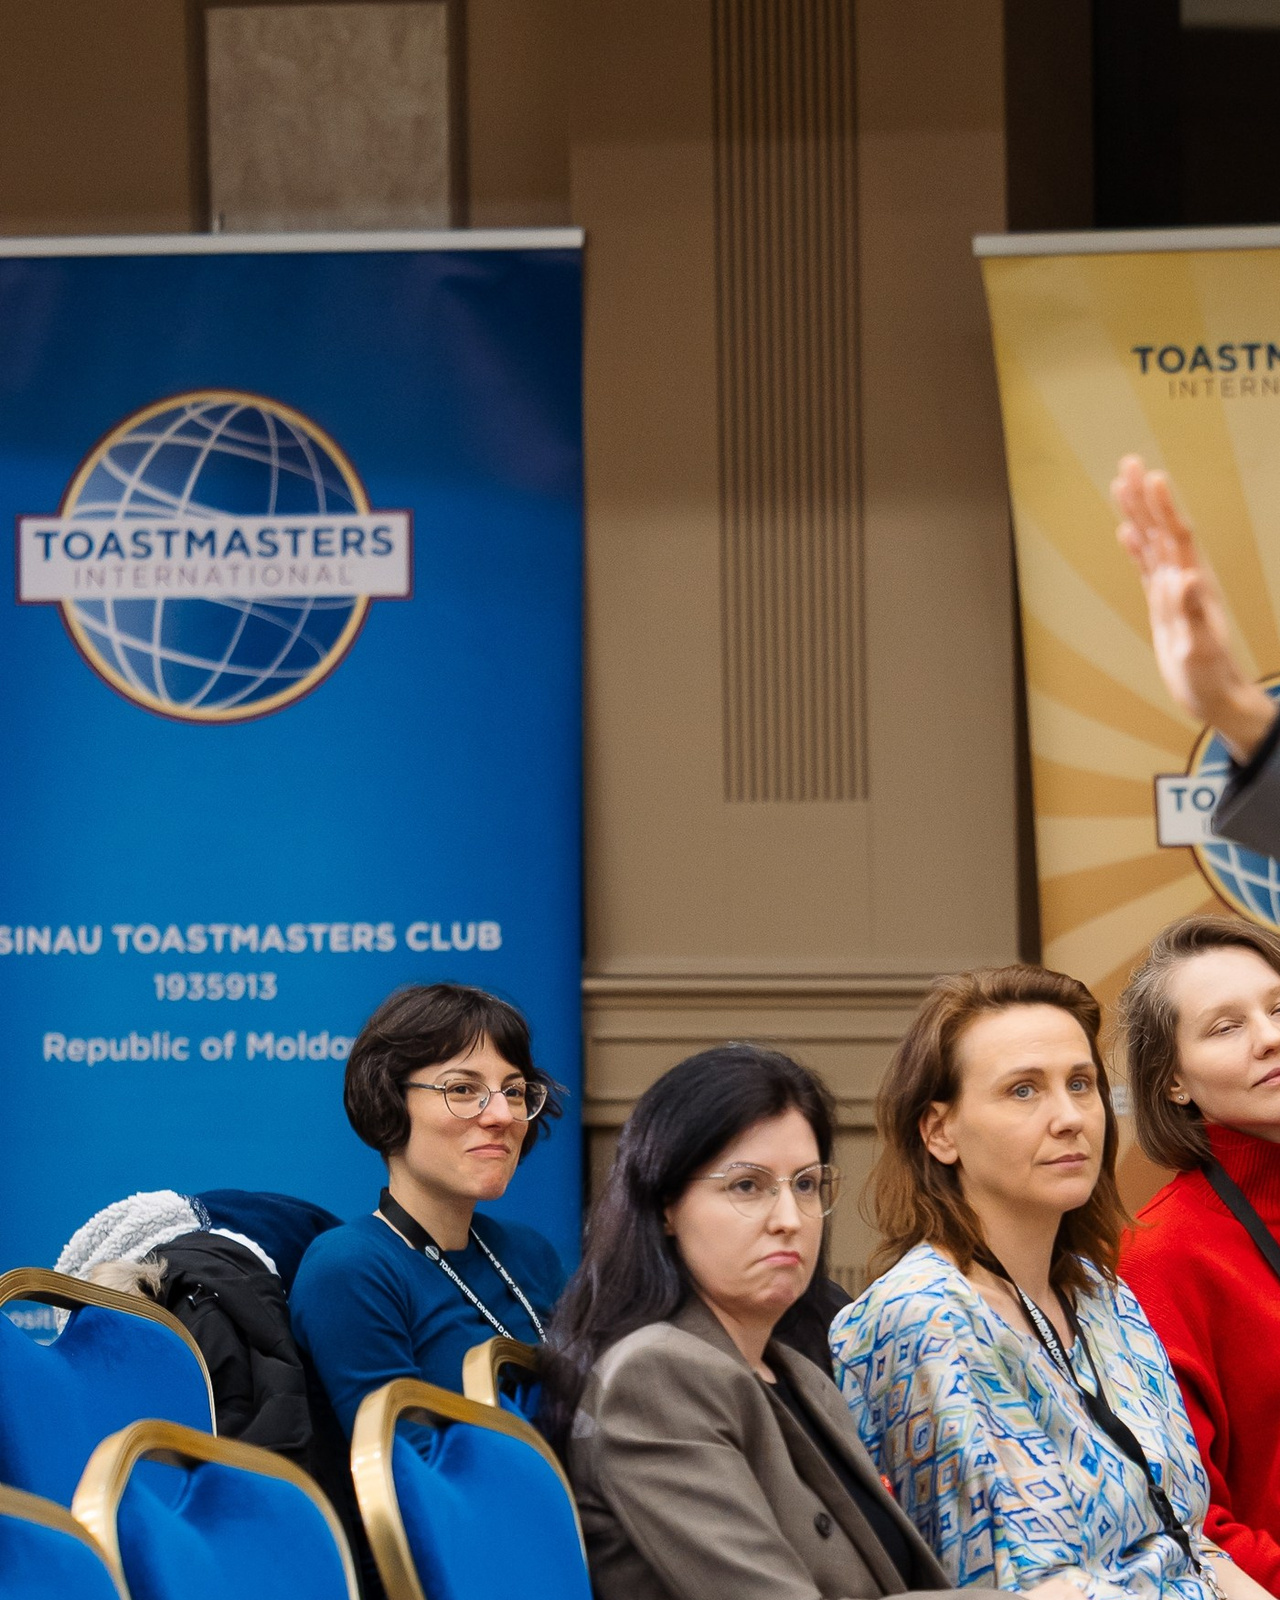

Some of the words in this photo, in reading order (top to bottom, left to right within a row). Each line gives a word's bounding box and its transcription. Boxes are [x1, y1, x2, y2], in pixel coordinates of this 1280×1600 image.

[35, 525, 394, 562] TOASTMASTERS
[74, 563, 352, 589] INTERNATIONAL
[111, 923, 396, 954] TOASTMASTERS
[405, 921, 503, 951] CLUB
[153, 972, 278, 1001] 1935913
[43, 1031, 190, 1067] Republic
[200, 1030, 236, 1061] of
[246, 1030, 356, 1061] Moldo
